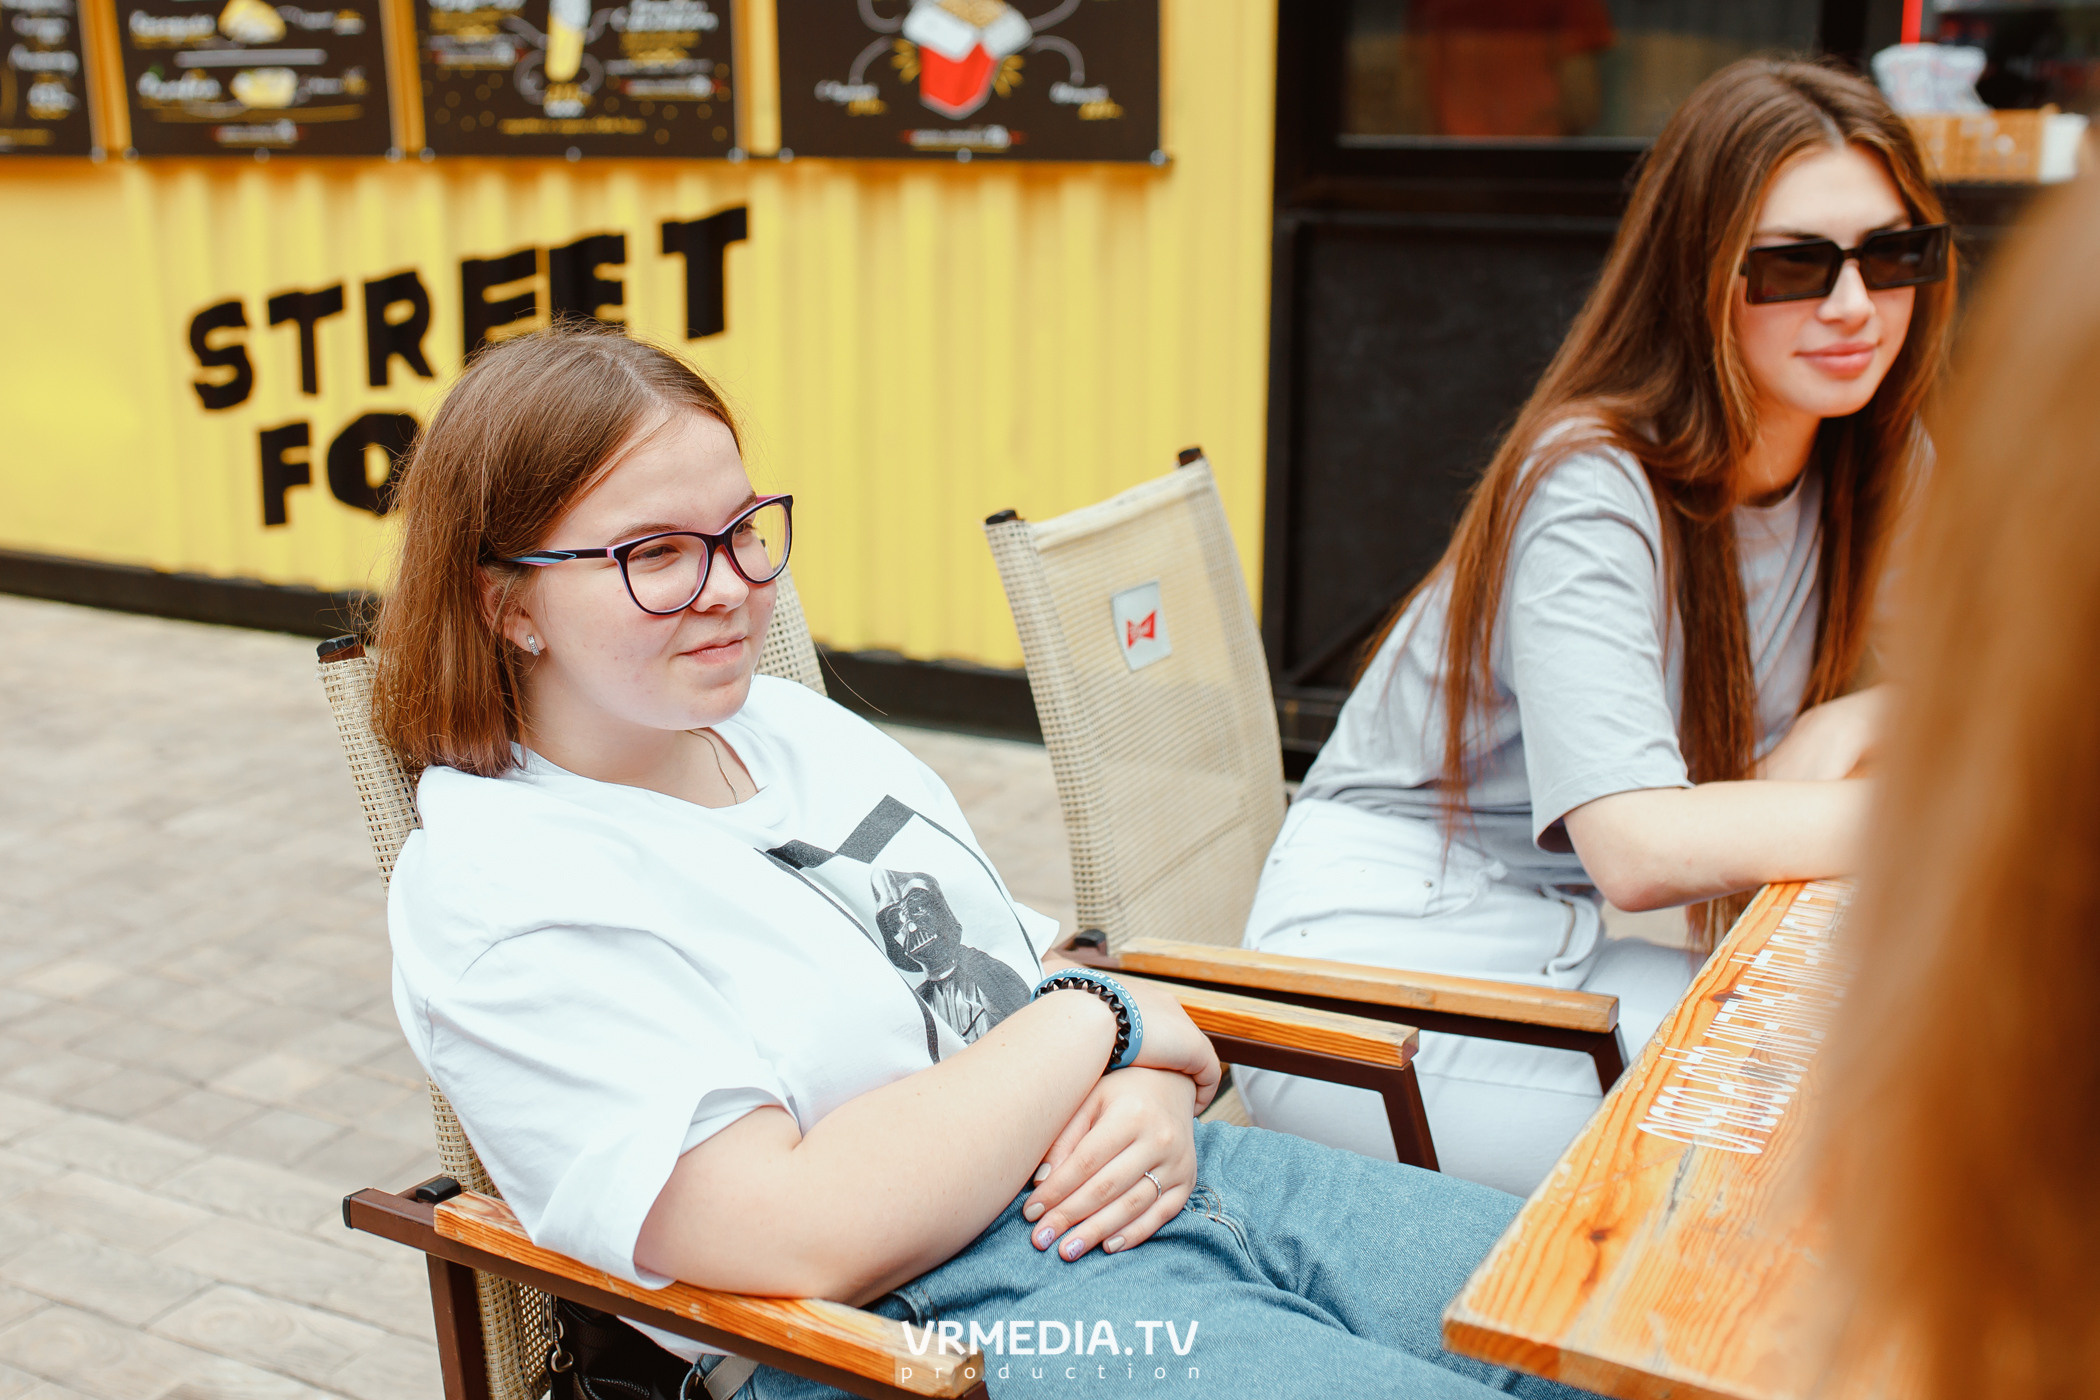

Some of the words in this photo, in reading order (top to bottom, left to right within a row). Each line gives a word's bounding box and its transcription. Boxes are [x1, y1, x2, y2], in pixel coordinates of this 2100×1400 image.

[189, 204, 748, 411] STREET
[259, 411, 419, 527] FO
[1106, 978, 1142, 1039] КУЗБАСС
[1702, 984, 1845, 1061] ВАШЕМУ
[1636, 1045, 1809, 1154] ЗДОРОВЬЮ
